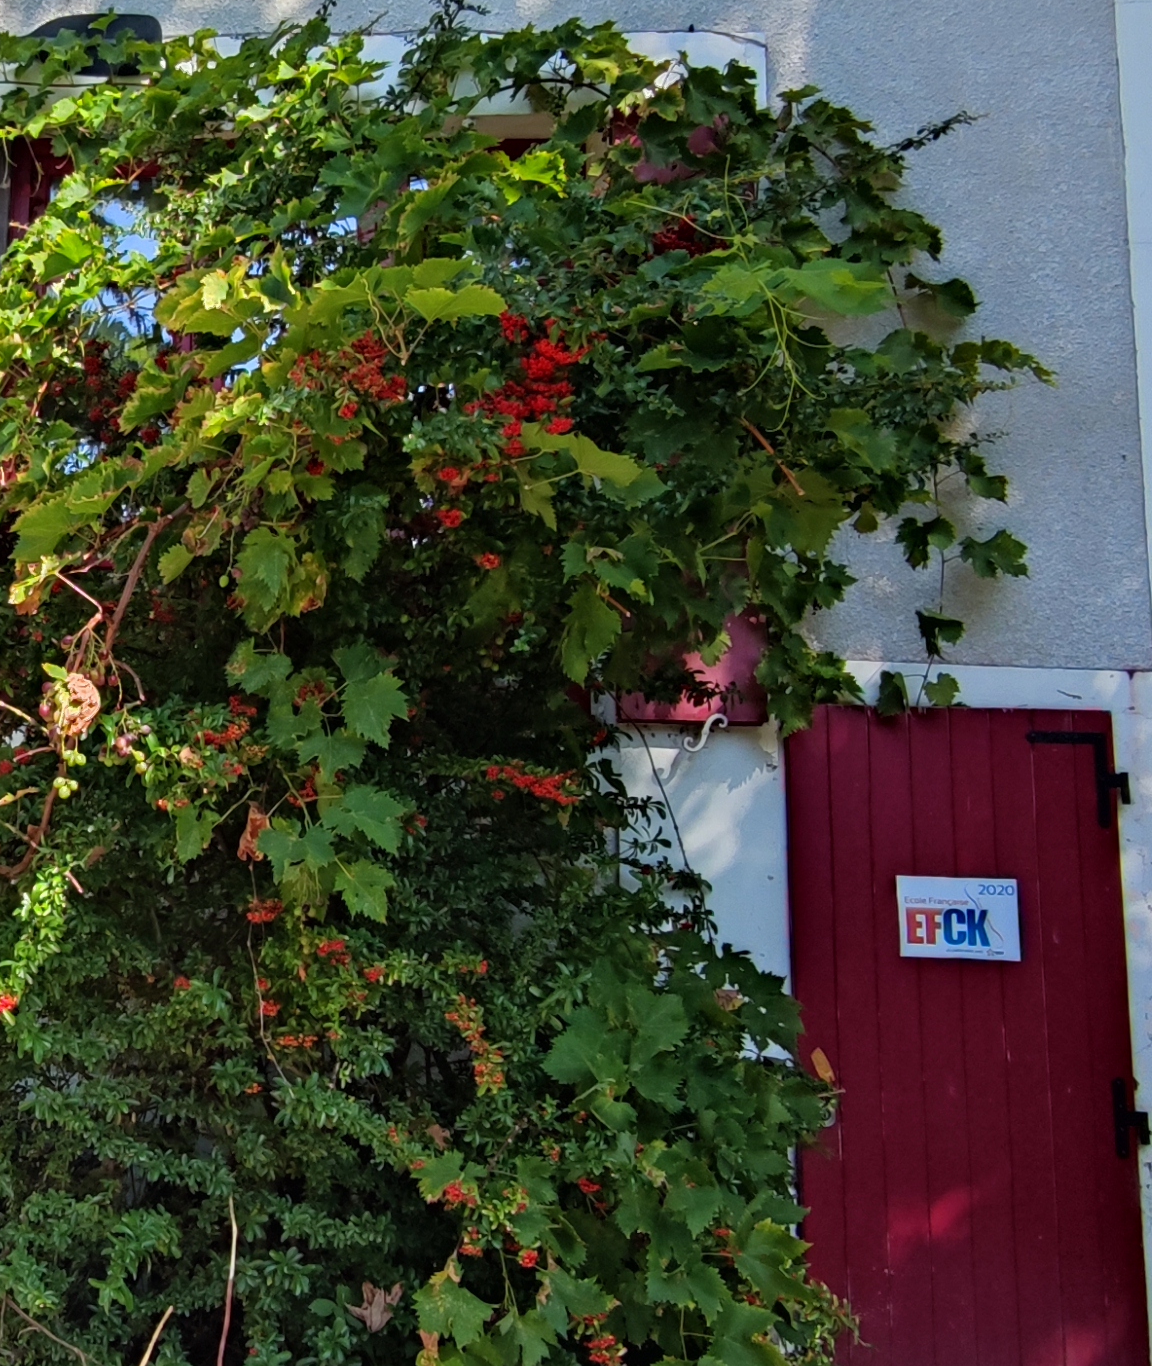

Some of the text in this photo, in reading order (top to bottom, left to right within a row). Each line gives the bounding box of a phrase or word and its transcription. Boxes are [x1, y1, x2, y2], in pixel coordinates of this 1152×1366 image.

[978, 884, 1014, 896] 2020
[904, 896, 927, 904] Ecole
[906, 907, 990, 947] EFCK
